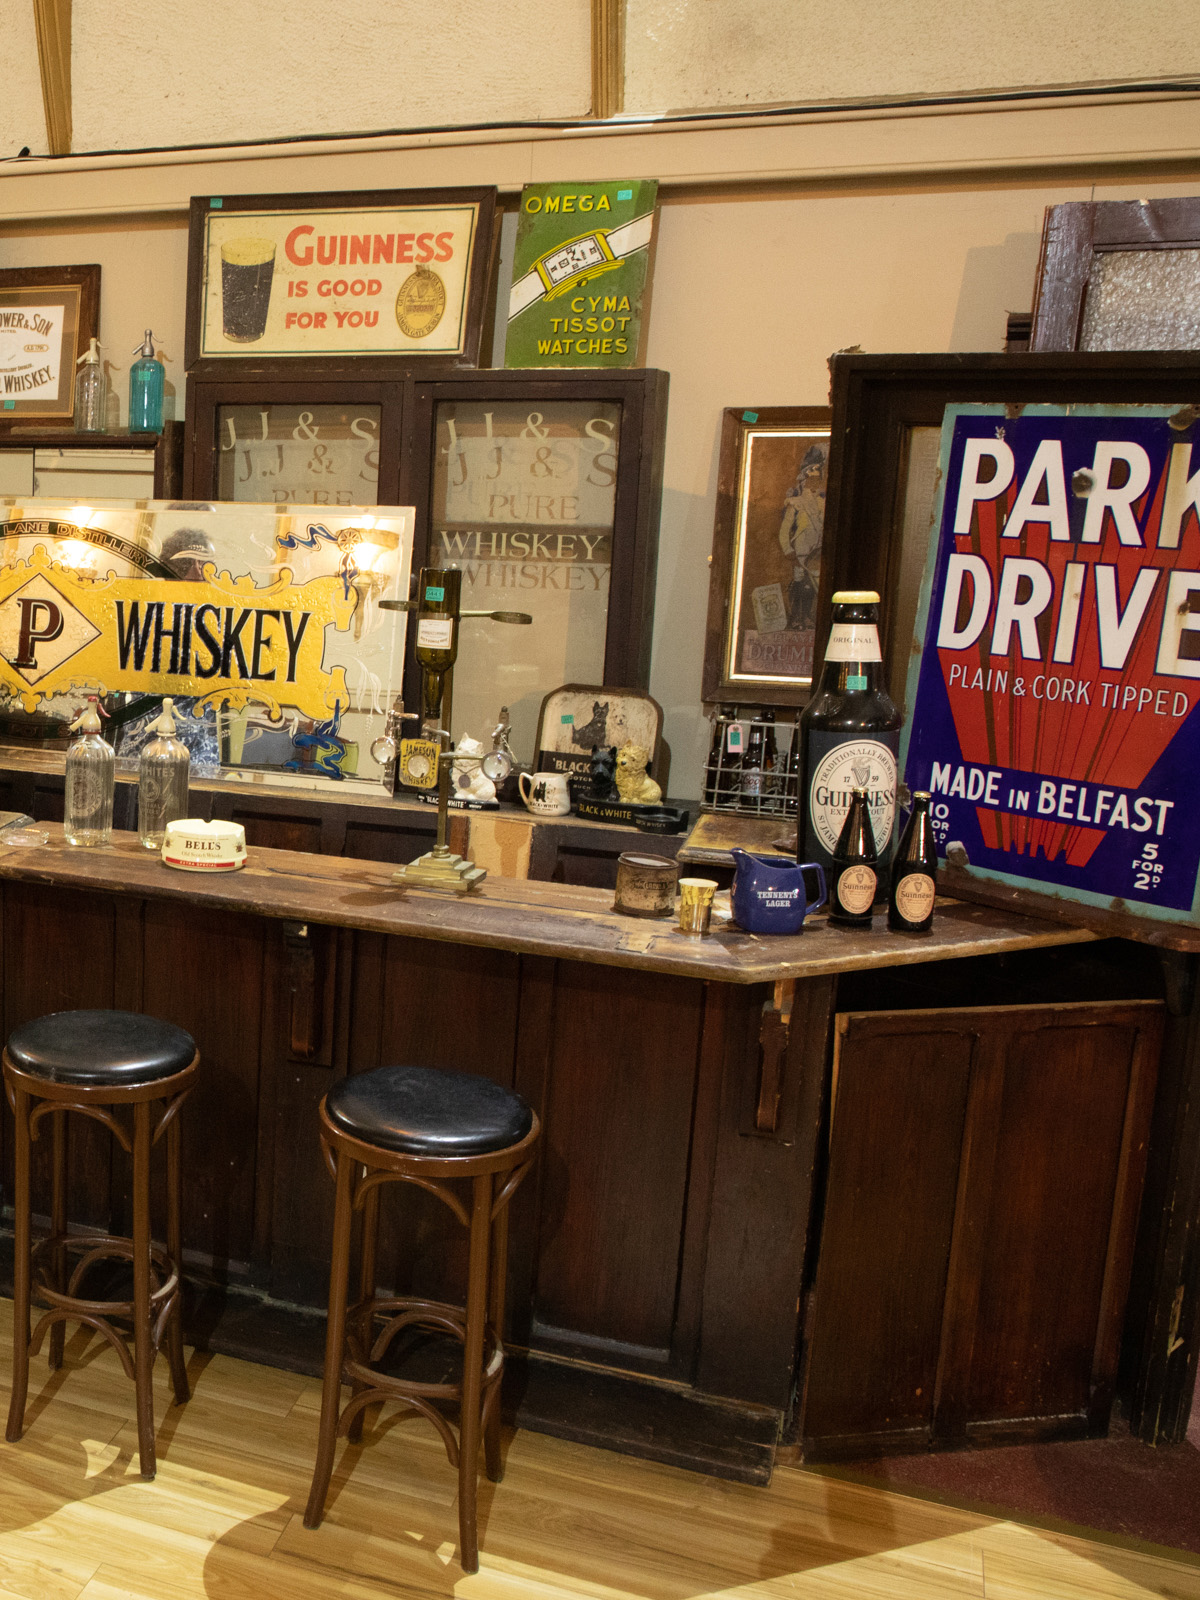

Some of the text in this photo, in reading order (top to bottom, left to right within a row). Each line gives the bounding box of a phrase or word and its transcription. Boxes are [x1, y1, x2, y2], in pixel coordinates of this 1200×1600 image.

[525, 194, 611, 214] OMEGA
[284, 224, 454, 267] GUINNESS
[287, 279, 382, 298] IS GOOD
[571, 296, 631, 313] CYMA
[30, 313, 54, 337] SON
[285, 310, 380, 330] FOR YOU
[550, 317, 631, 333] TISSOT
[537, 338, 628, 355] WATCHES
[292, 411, 319, 442] &
[351, 417, 377, 450] S
[519, 412, 550, 442] &
[584, 418, 615, 453] S
[953, 437, 1200, 549] PARK
[487, 494, 581, 520] PURE
[2, 521, 49, 536] LANE
[56, 523, 154, 567] DISTILLERY
[440, 530, 604, 560] WHISKEY
[936, 552, 1200, 680] DRIVE
[9, 597, 64, 670] P
[115, 600, 313, 684] WHISKEY
[949, 663, 1189, 718] PLAIN & CORK TIPPED
[405, 743, 437, 762] JAMESON
[821, 748, 877, 783] TRADITIONALLY
[929, 761, 1175, 836] MADE IN BELFAST
[579, 804, 599, 816] BLACK
[604, 808, 632, 820] WHITE
[830, 808, 849, 816] EXT
[931, 820, 949, 831] OR
[185, 840, 221, 850] BELL'S
[1141, 842, 1159, 860] 5
[1131, 860, 1164, 874] FOR
[766, 900, 791, 908] LAGER
